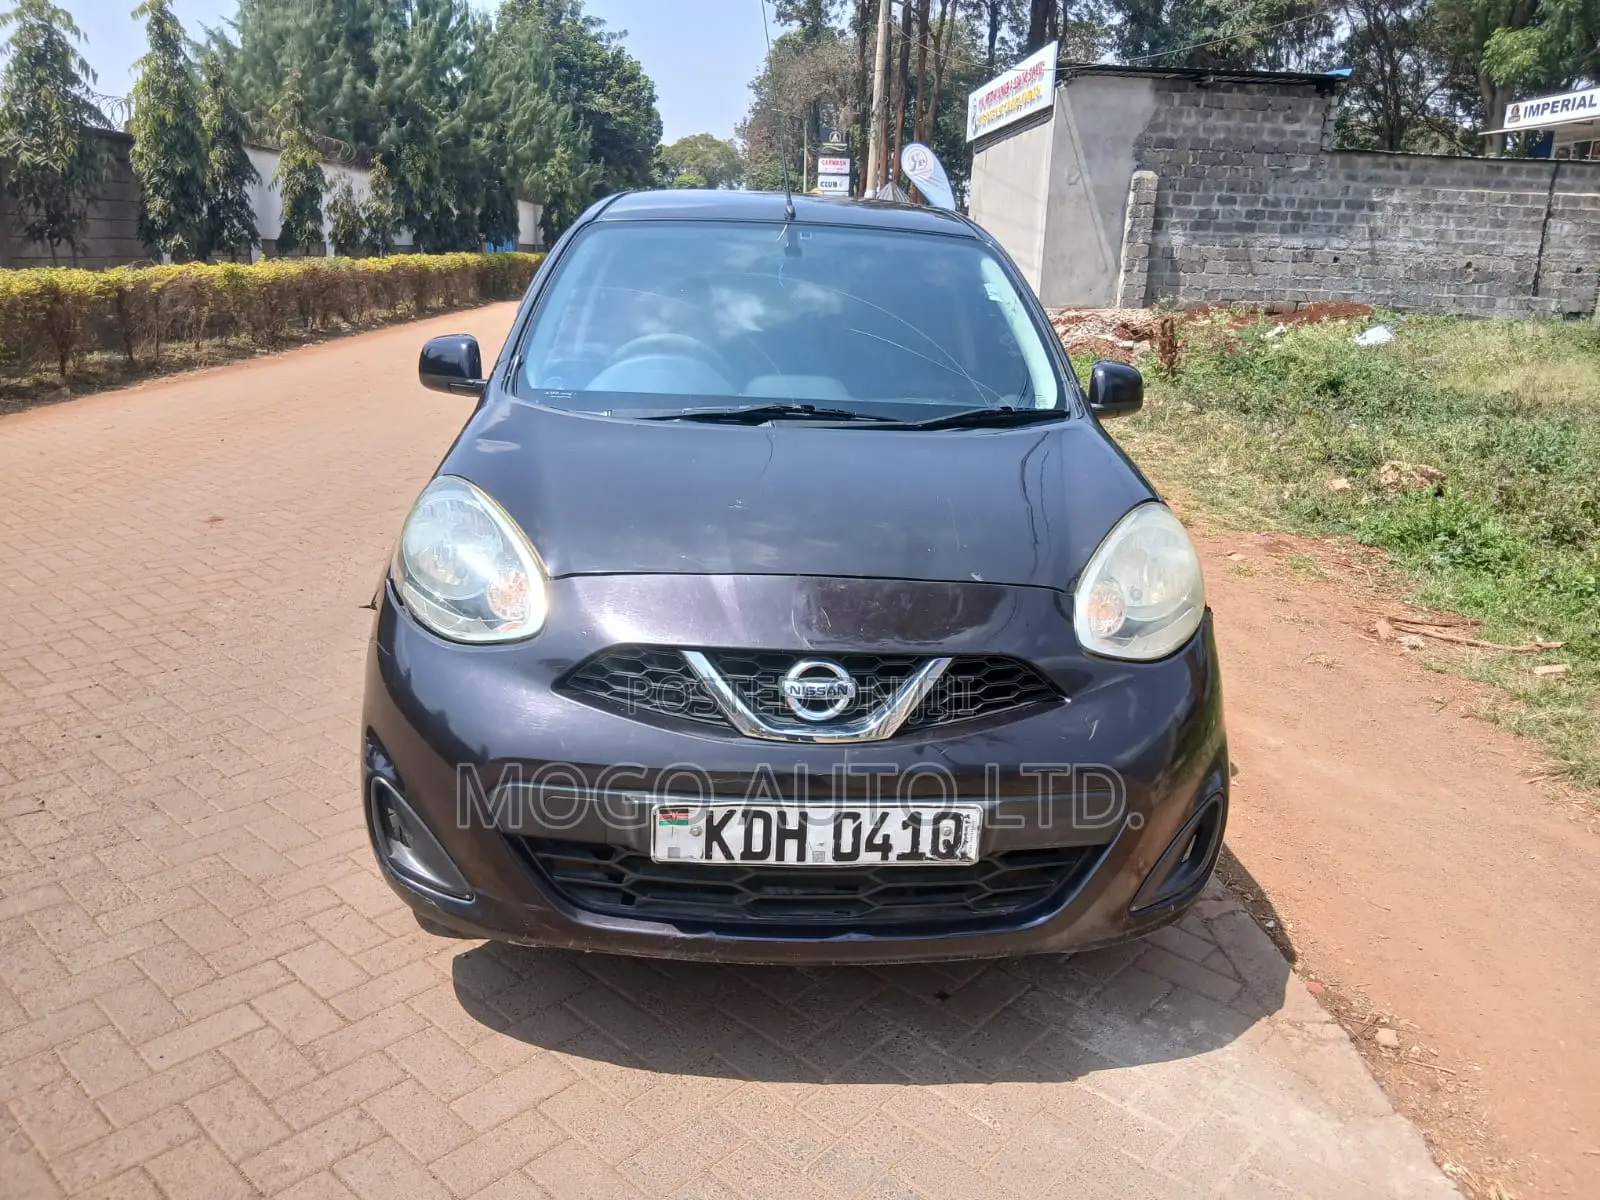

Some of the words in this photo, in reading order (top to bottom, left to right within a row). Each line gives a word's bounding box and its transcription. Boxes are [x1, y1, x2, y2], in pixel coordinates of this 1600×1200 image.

[1523, 94, 1597, 119] IMPERIAL
[821, 159, 847, 167] CARWASH
[820, 180, 838, 188] CLUB
[789, 685, 849, 697] NISSAN
[704, 809, 808, 862] KDH
[832, 811, 964, 863] 041Q
